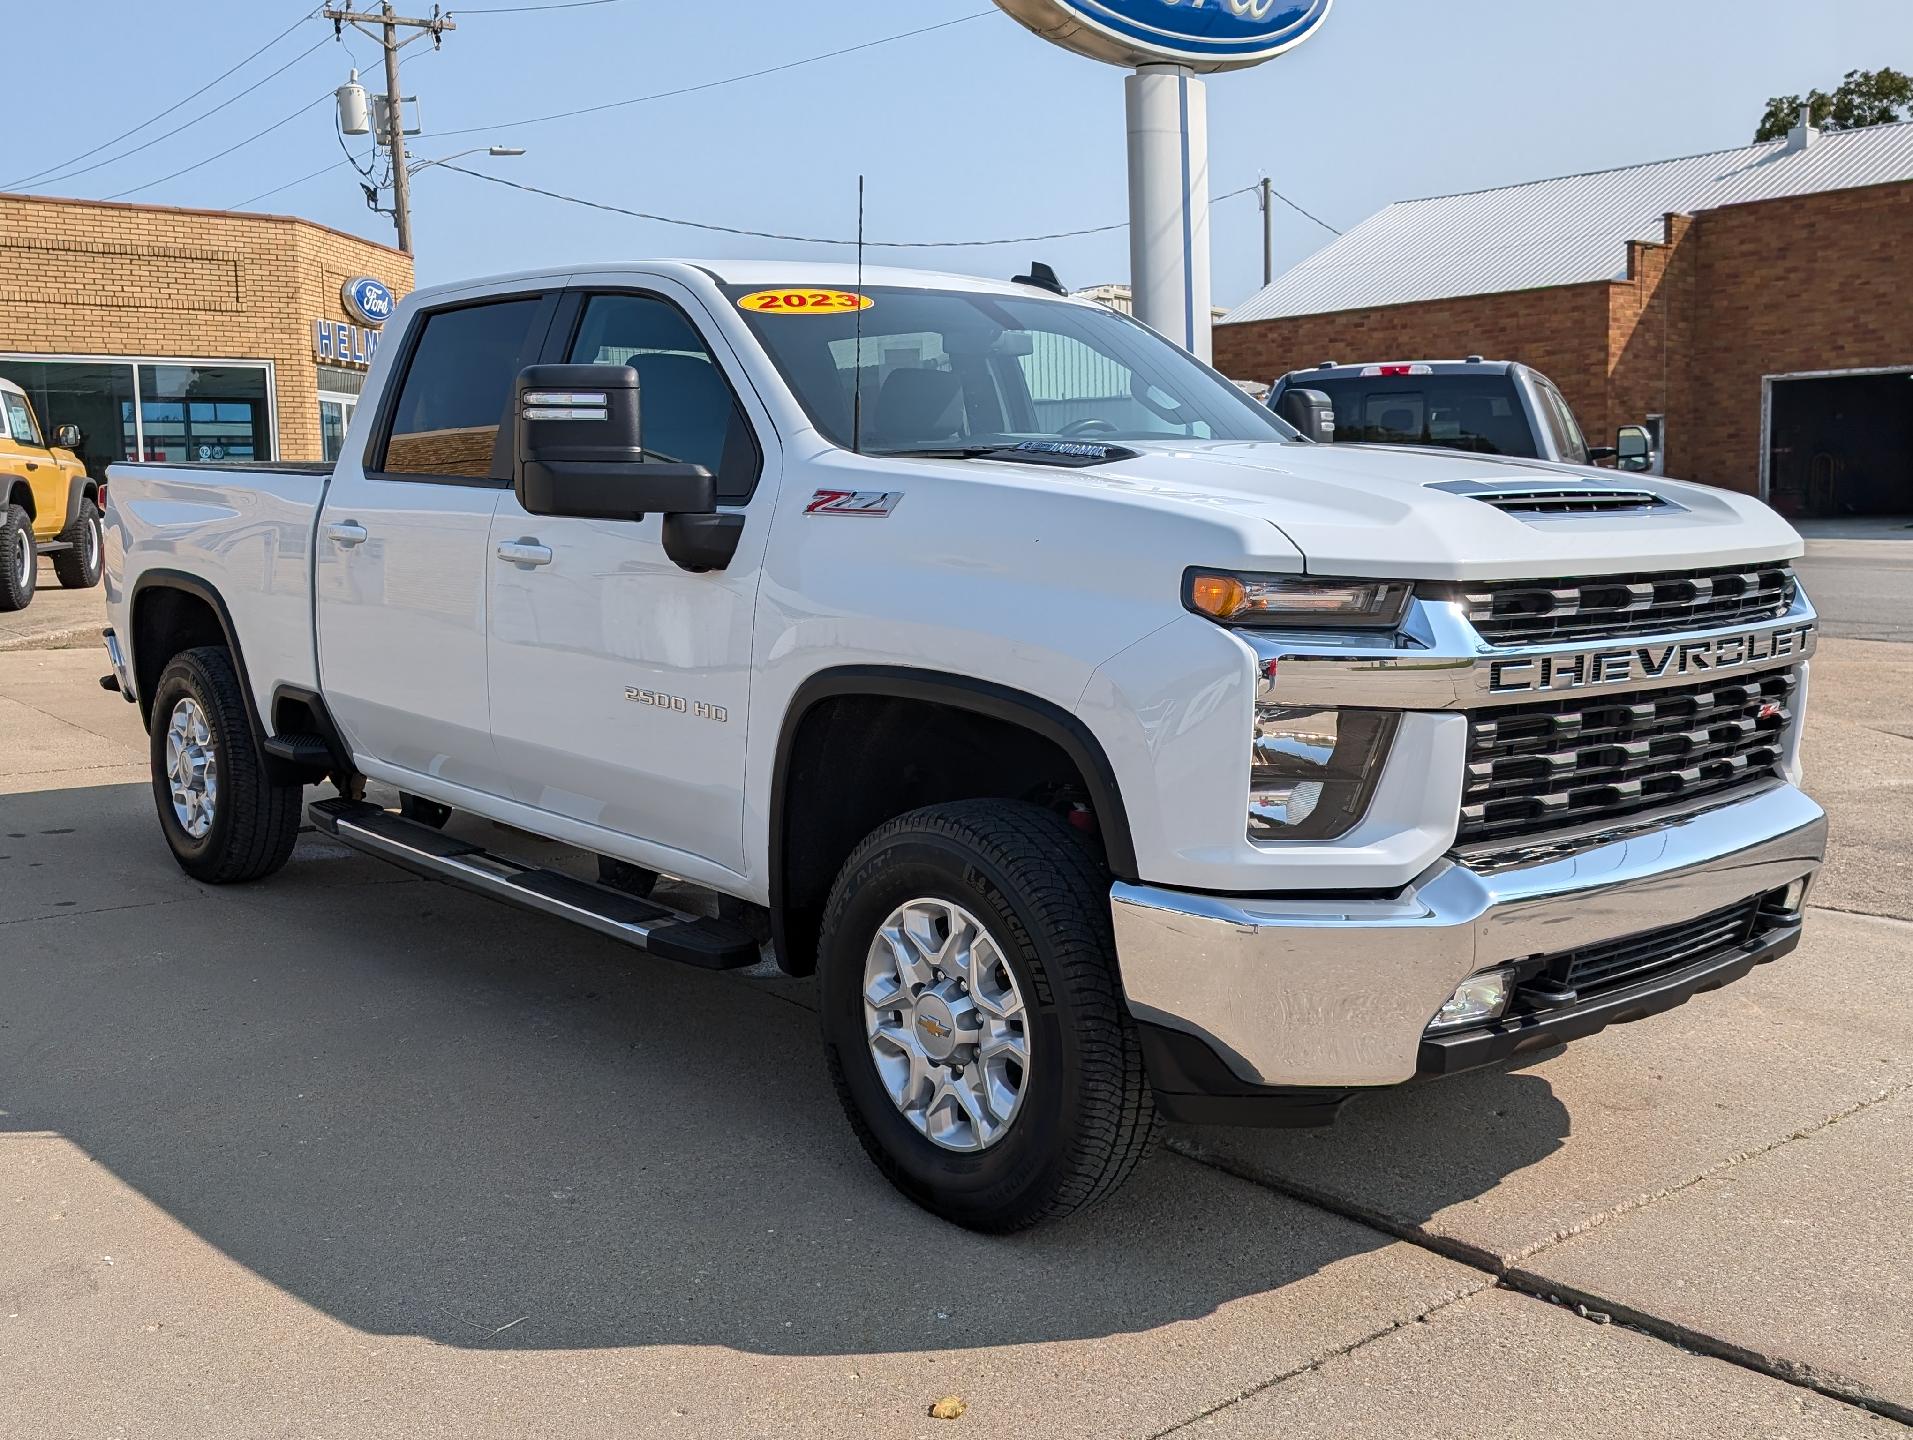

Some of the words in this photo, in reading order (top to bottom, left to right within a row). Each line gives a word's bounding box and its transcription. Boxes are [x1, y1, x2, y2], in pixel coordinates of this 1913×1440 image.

[363, 285, 389, 314] Ford
[756, 293, 861, 309] 2023
[802, 488, 905, 518] Z71
[1489, 623, 1815, 693] CHEVROLET
[624, 686, 687, 713] 2500
[693, 700, 728, 722] HD
[985, 887, 1055, 1006] MICHELIN
